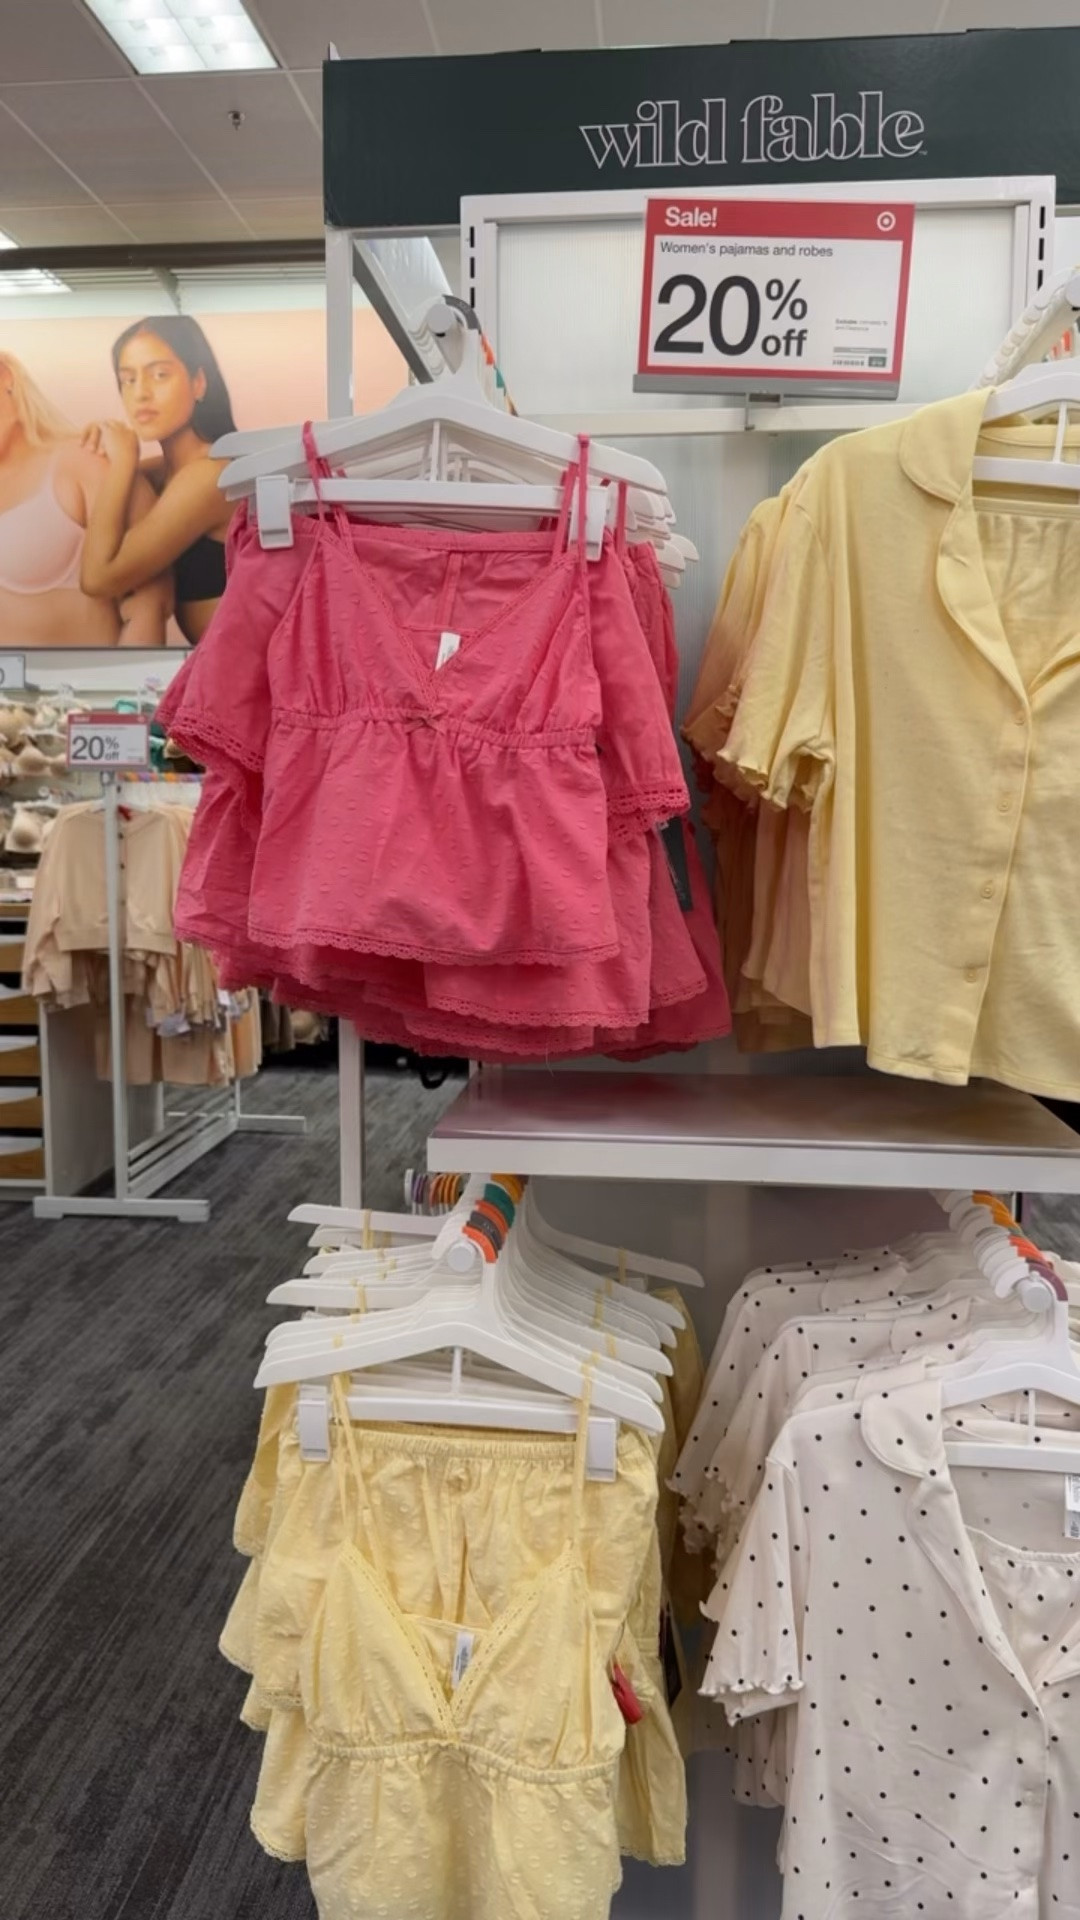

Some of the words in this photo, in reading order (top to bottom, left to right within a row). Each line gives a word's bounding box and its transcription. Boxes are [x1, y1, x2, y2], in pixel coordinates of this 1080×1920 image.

[579, 98, 727, 169] wild
[740, 91, 925, 163] fable
[664, 206, 718, 228] Sale!
[660, 241, 717, 254] Women's
[719, 243, 770, 257] pajamas
[772, 244, 796, 256] and
[799, 245, 834, 257] robes
[761, 328, 808, 357] off
[104, 751, 119, 761] off
